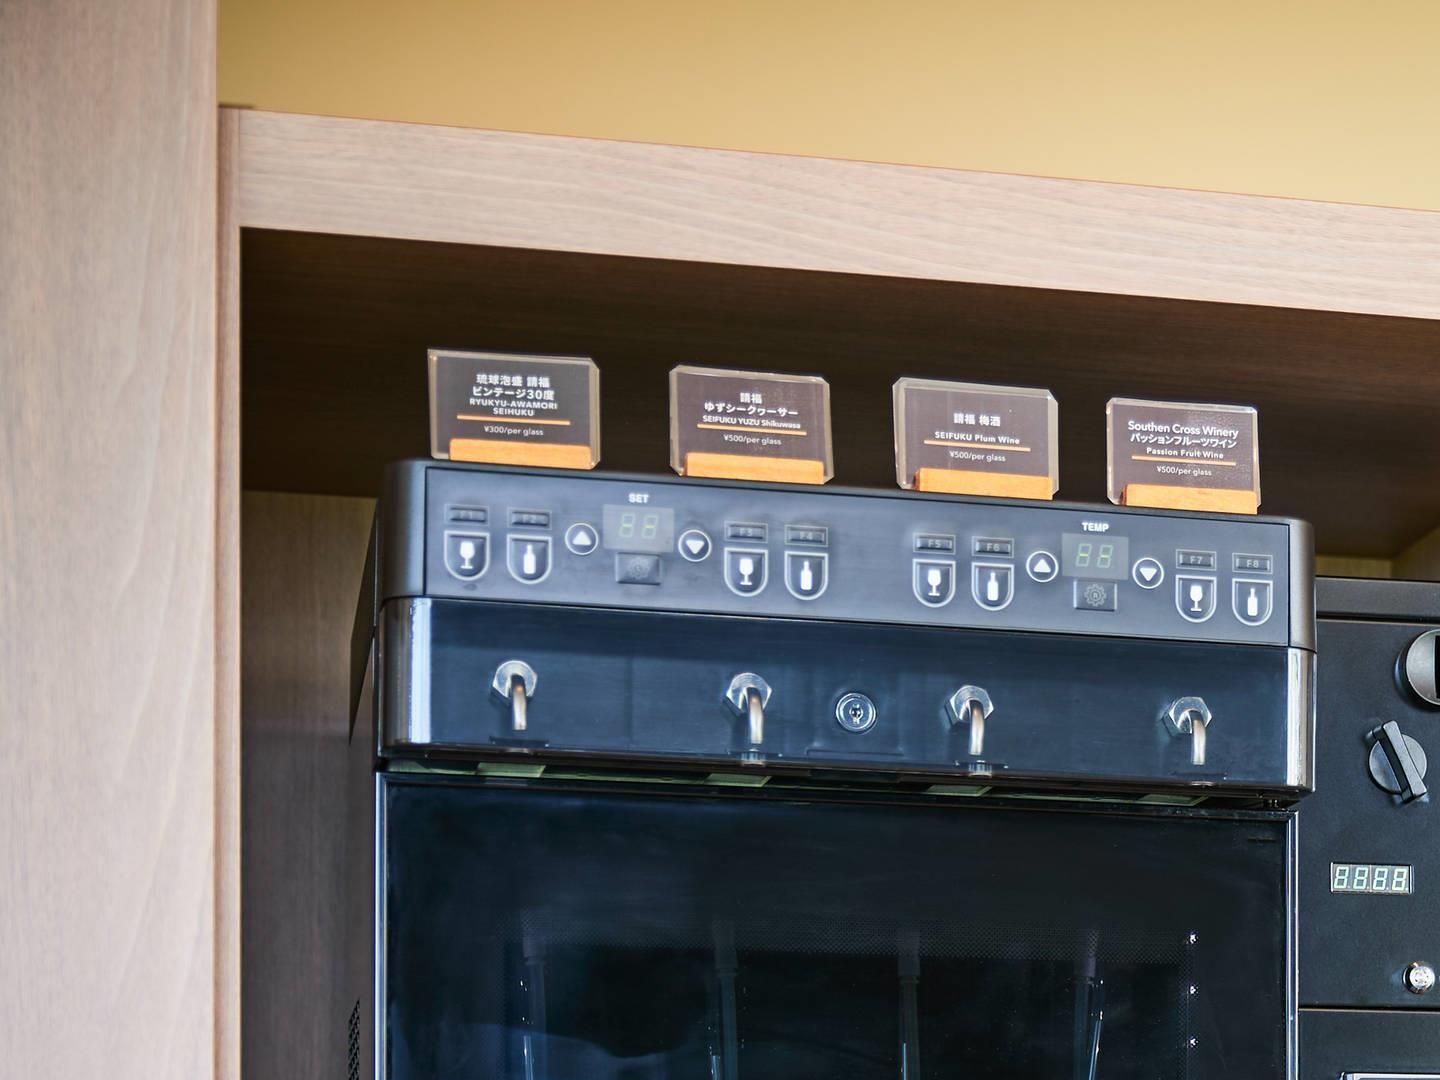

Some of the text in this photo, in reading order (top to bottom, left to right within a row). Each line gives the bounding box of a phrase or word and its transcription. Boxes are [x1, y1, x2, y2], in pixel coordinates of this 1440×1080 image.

[475, 373, 551, 389] 琉球泡盛 請福
[472, 386, 555, 401] ビンテージ30度
[469, 397, 558, 410] RYUKYU-AWAMORI
[703, 401, 799, 417] ゆずシークヮーサー
[492, 407, 536, 417] SEIHUKU
[702, 415, 737, 425] SEIFUKU
[737, 417, 761, 427] YUZU
[977, 414, 1001, 428] 梅酒
[522, 427, 544, 437] glass
[1127, 420, 1239, 440] Southen Cross Winery
[761, 437, 782, 446] glass
[934, 431, 1020, 446] SEIFUKU Plum Wine
[1129, 433, 1238, 449] パッションフルーツワイン
[986, 452, 1006, 464] glass
[1146, 447, 1224, 460] Passion Fruit Wine
[1192, 467, 1212, 478] glass
[628, 493, 650, 504] SET
[1082, 521, 1109, 533] TEMP
[1190, 555, 1203, 565] F7
